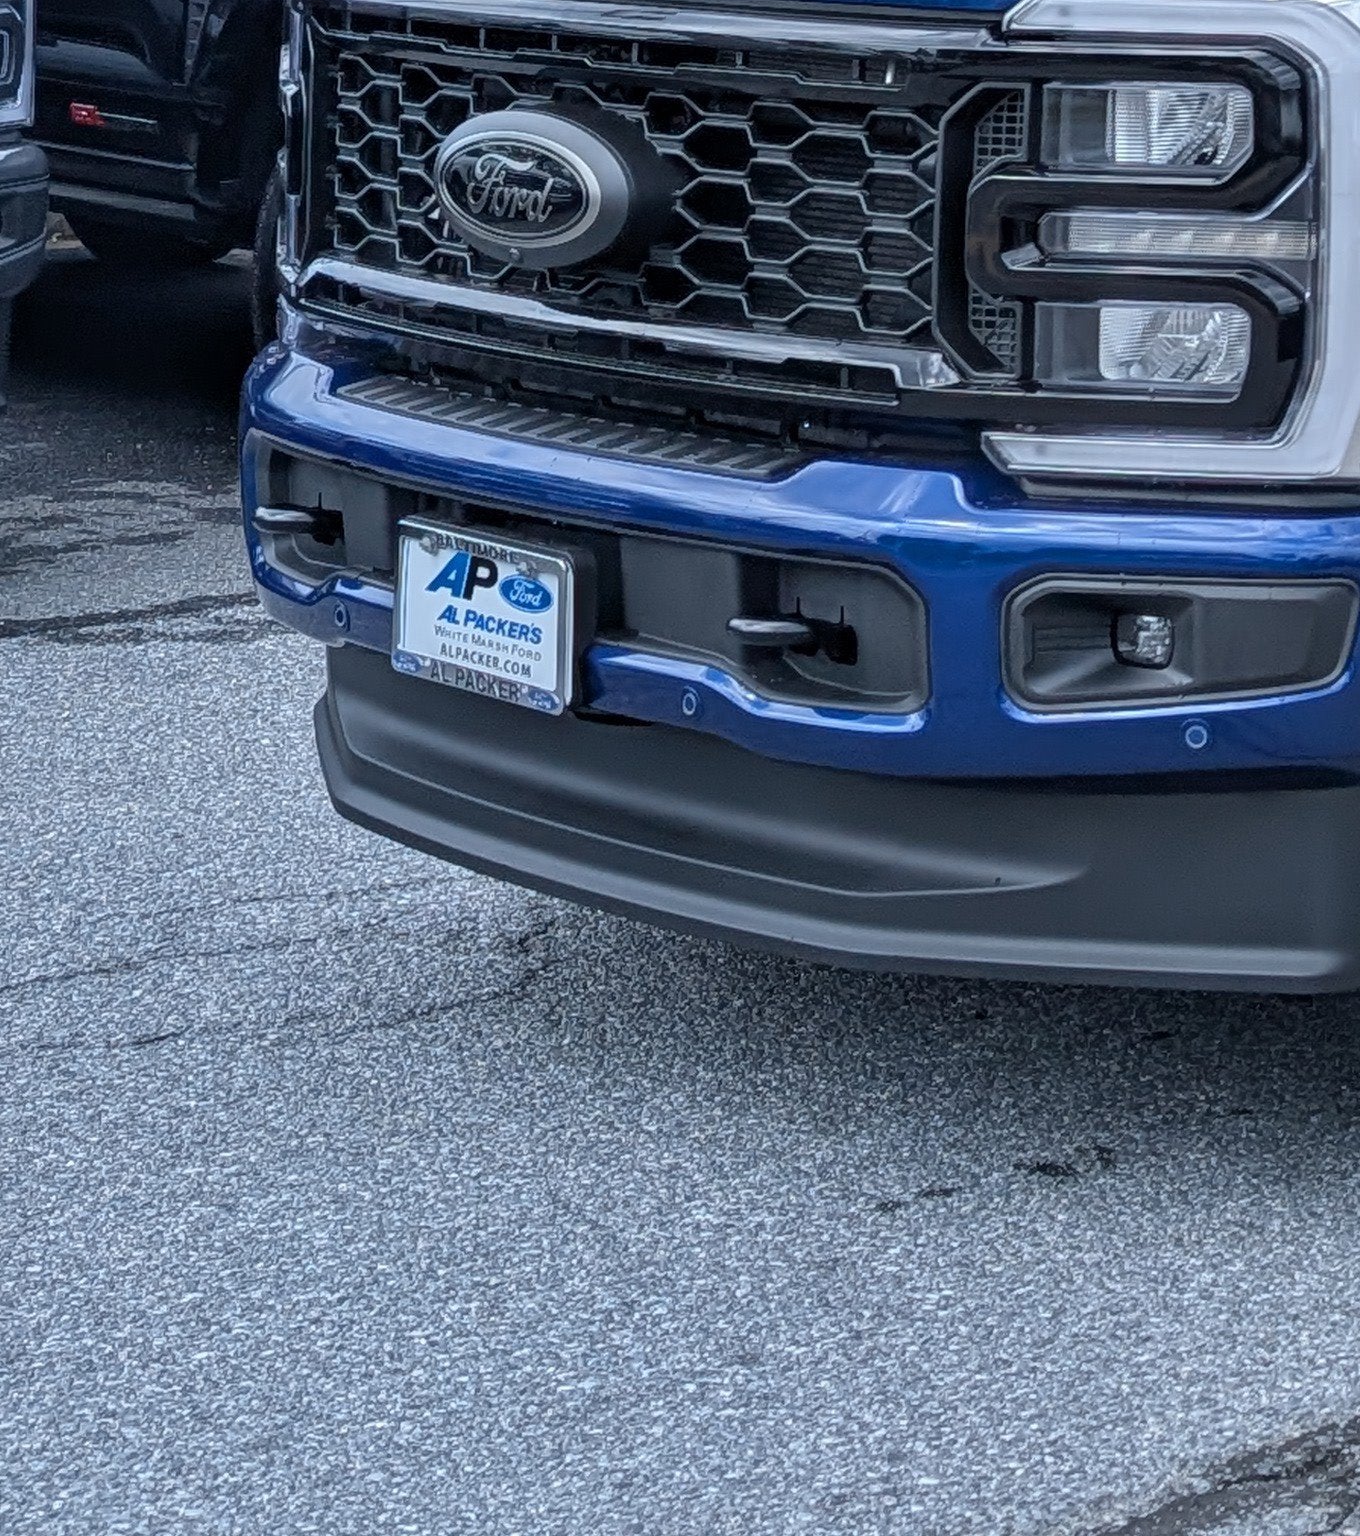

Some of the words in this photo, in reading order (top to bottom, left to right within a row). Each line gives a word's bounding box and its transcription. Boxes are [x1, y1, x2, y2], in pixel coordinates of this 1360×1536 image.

[466, 153, 553, 223] Ford
[425, 550, 499, 601] AP
[511, 579, 543, 607] Ford
[437, 604, 460, 626] AL
[464, 609, 543, 645] PACKER'S
[440, 642, 533, 679] ALPACKER.COM
[511, 644, 543, 662] FORD
[430, 660, 453, 684] AL
[455, 669, 522, 704] PACKER
